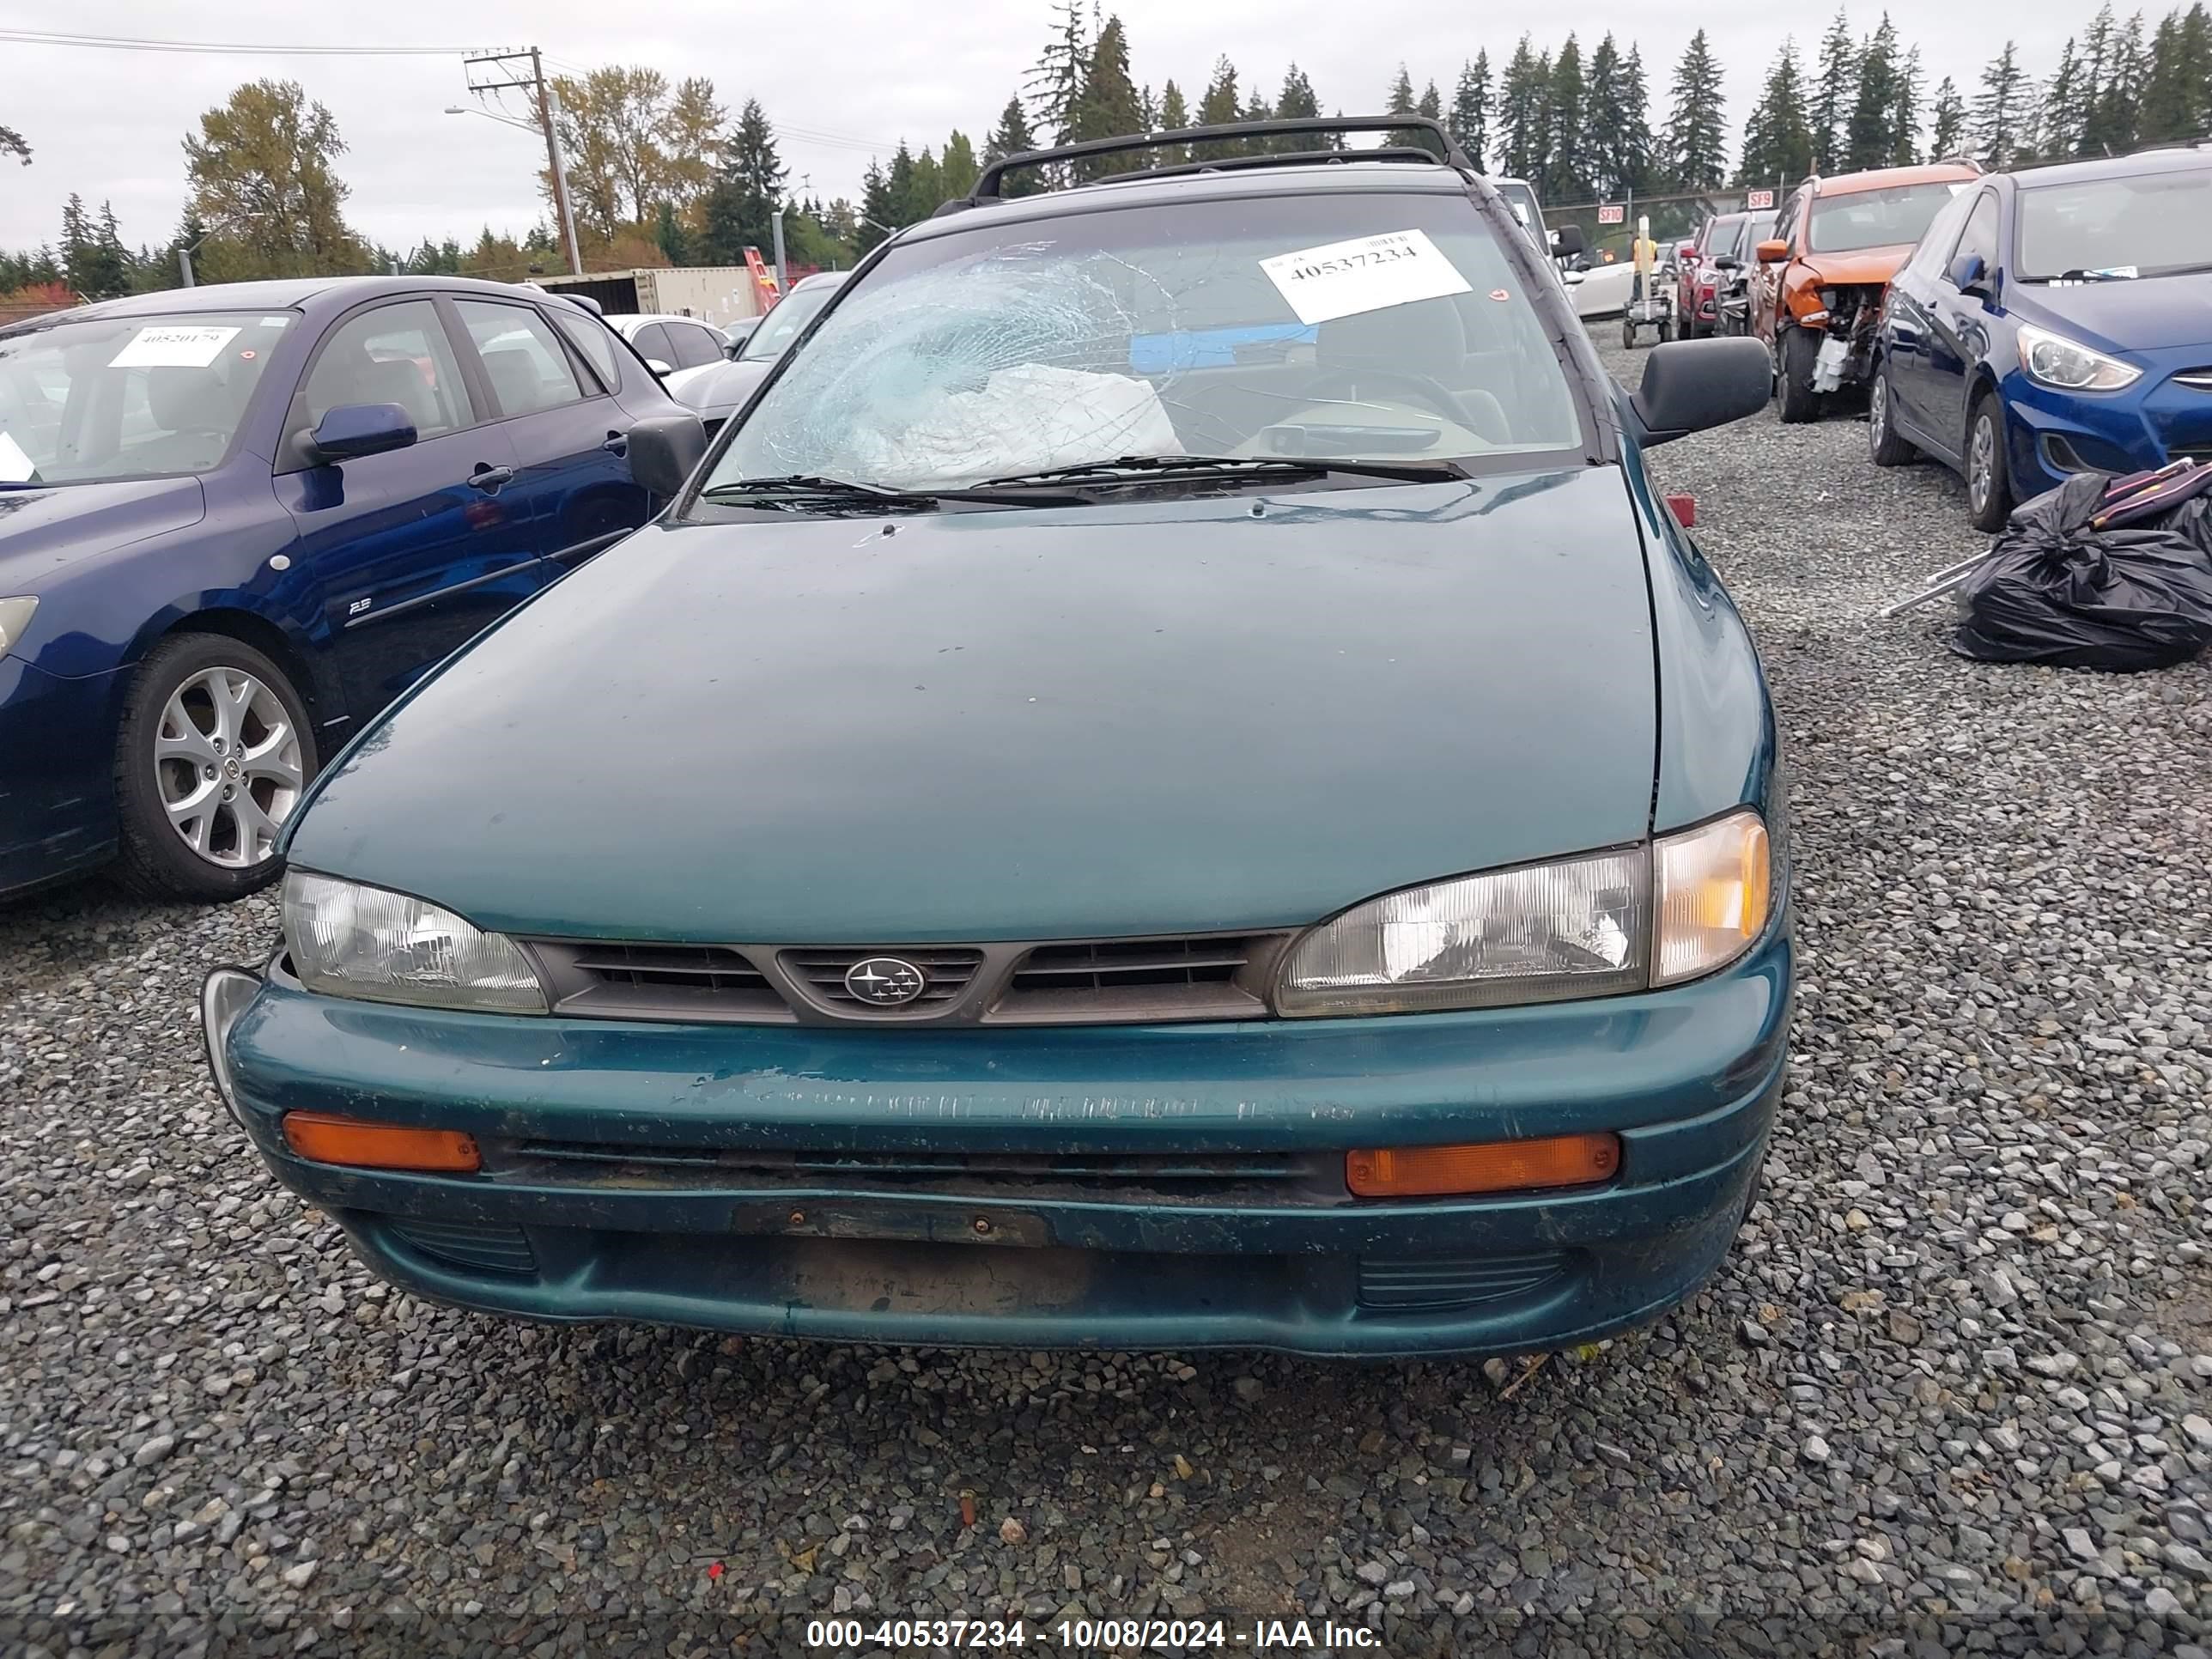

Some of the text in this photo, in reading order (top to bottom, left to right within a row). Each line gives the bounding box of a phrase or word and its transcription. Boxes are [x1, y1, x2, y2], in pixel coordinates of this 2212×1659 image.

[1749, 192, 1771, 208] SF9
[1599, 208, 1623, 222] SF10
[1291, 245, 1418, 281] 40537234
